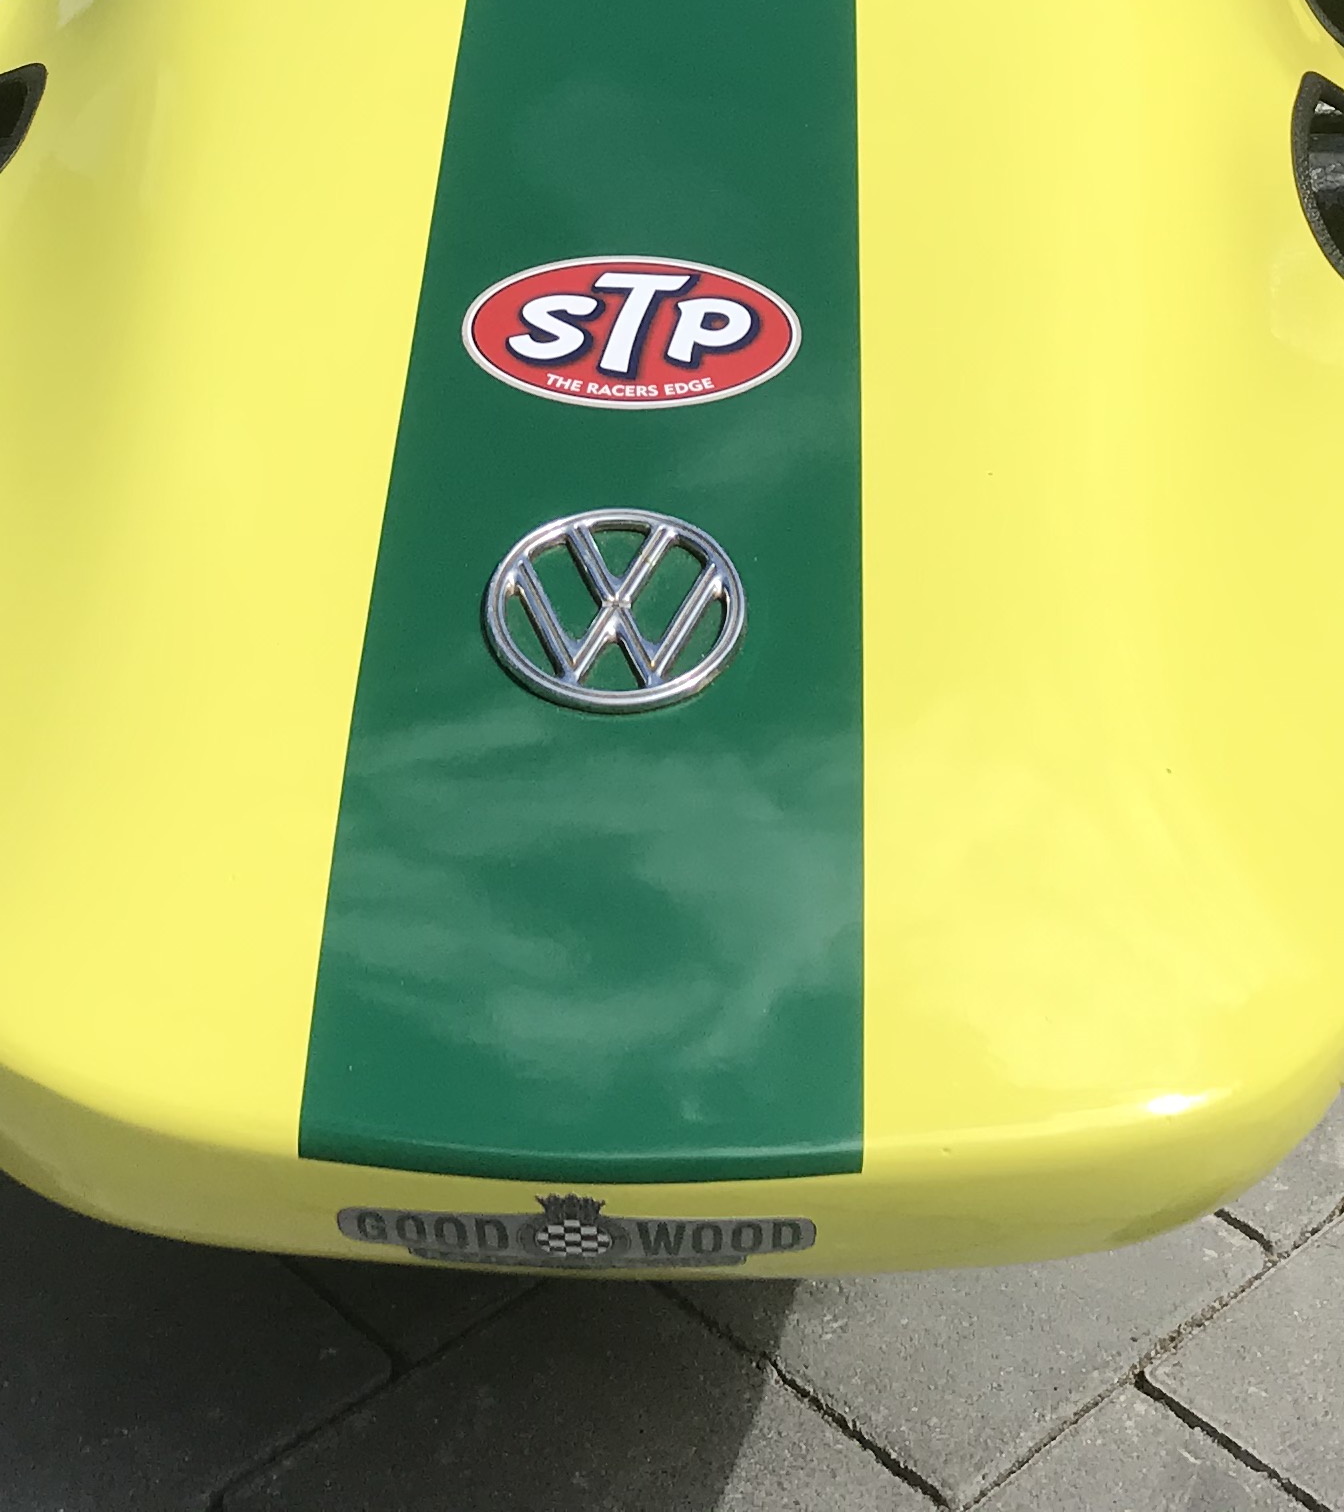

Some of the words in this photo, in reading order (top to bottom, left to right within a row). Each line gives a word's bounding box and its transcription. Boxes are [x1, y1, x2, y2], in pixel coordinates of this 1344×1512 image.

[506, 271, 758, 377] STP
[546, 372, 582, 393] THE
[585, 381, 660, 398] RACERS
[664, 376, 716, 397] EDGE
